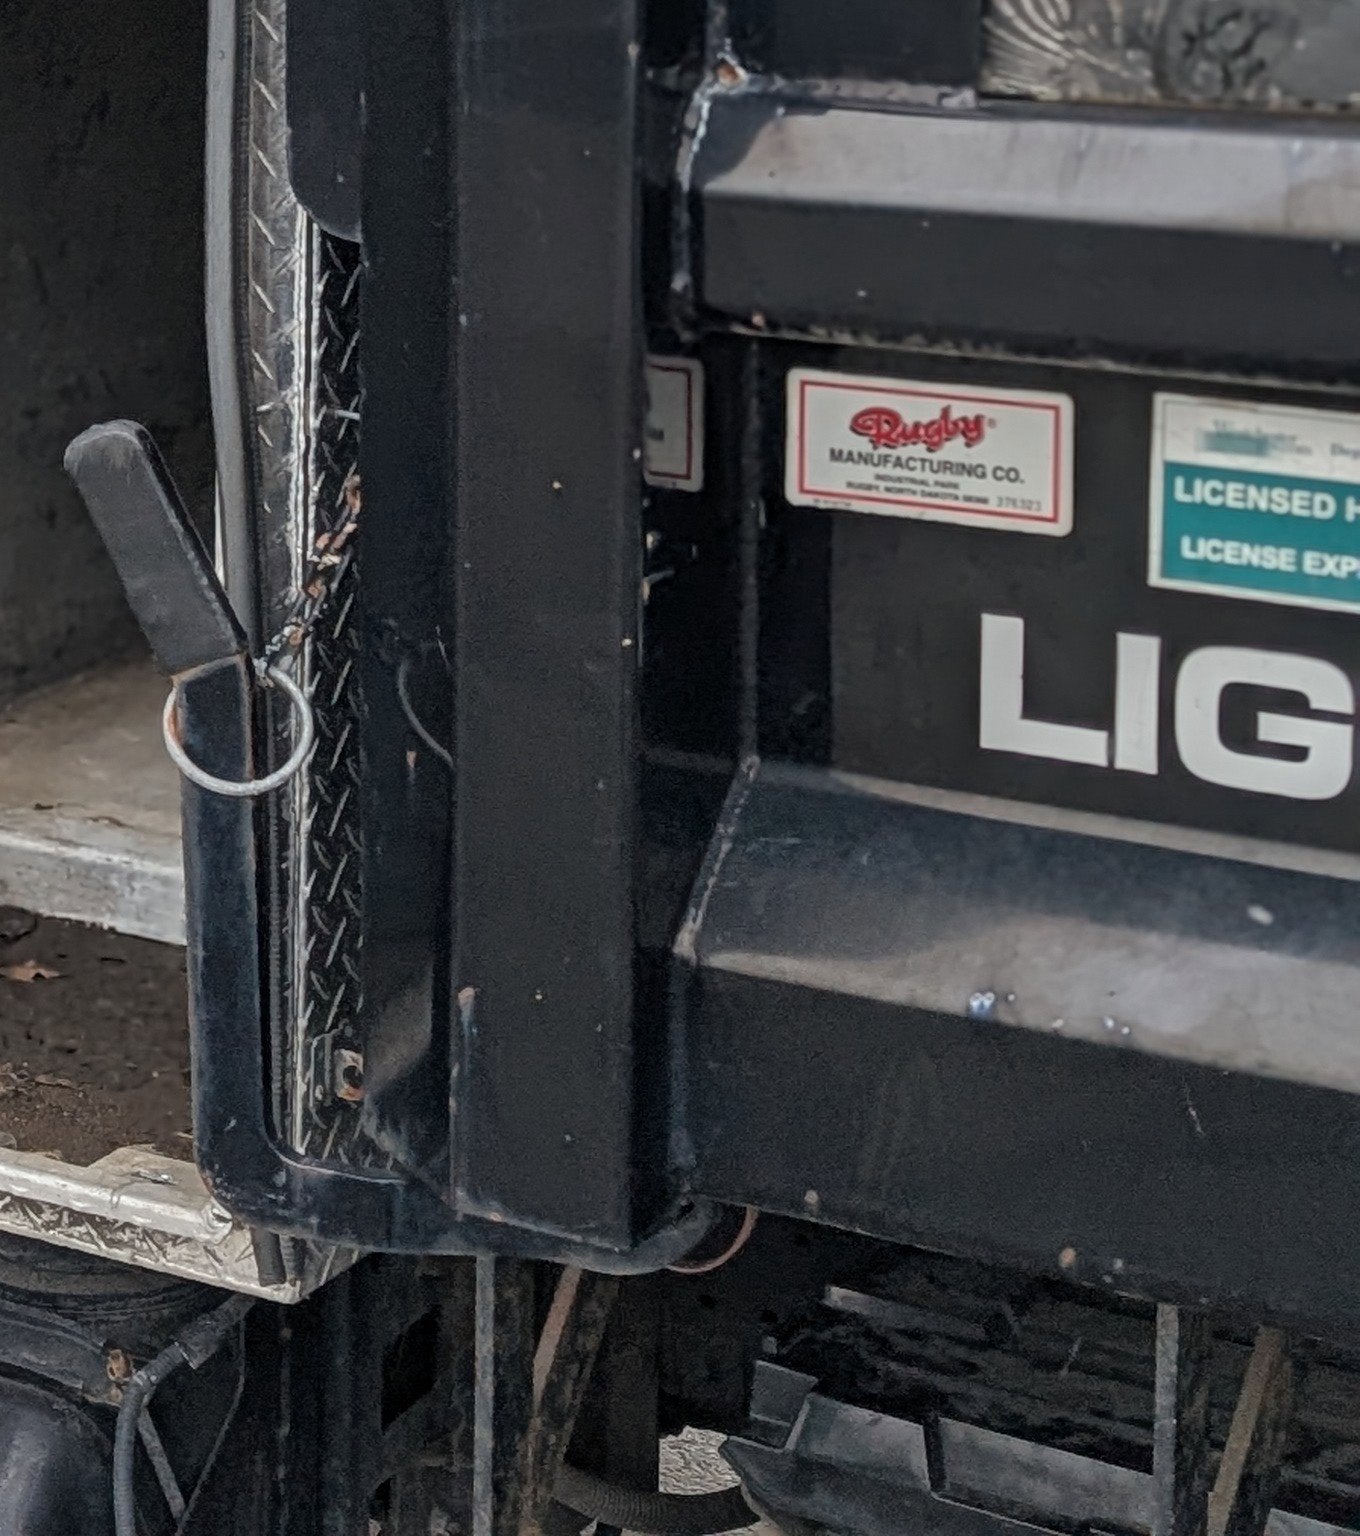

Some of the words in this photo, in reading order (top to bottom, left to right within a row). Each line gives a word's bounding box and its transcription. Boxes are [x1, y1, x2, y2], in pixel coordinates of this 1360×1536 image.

[850, 405, 984, 453] Rugby
[830, 447, 987, 479] MANUFACTURING
[992, 466, 1025, 484] CO.
[1174, 476, 1337, 520] LICENSED
[1181, 535, 1297, 572] LICENSE
[980, 612, 1354, 801] LIG
